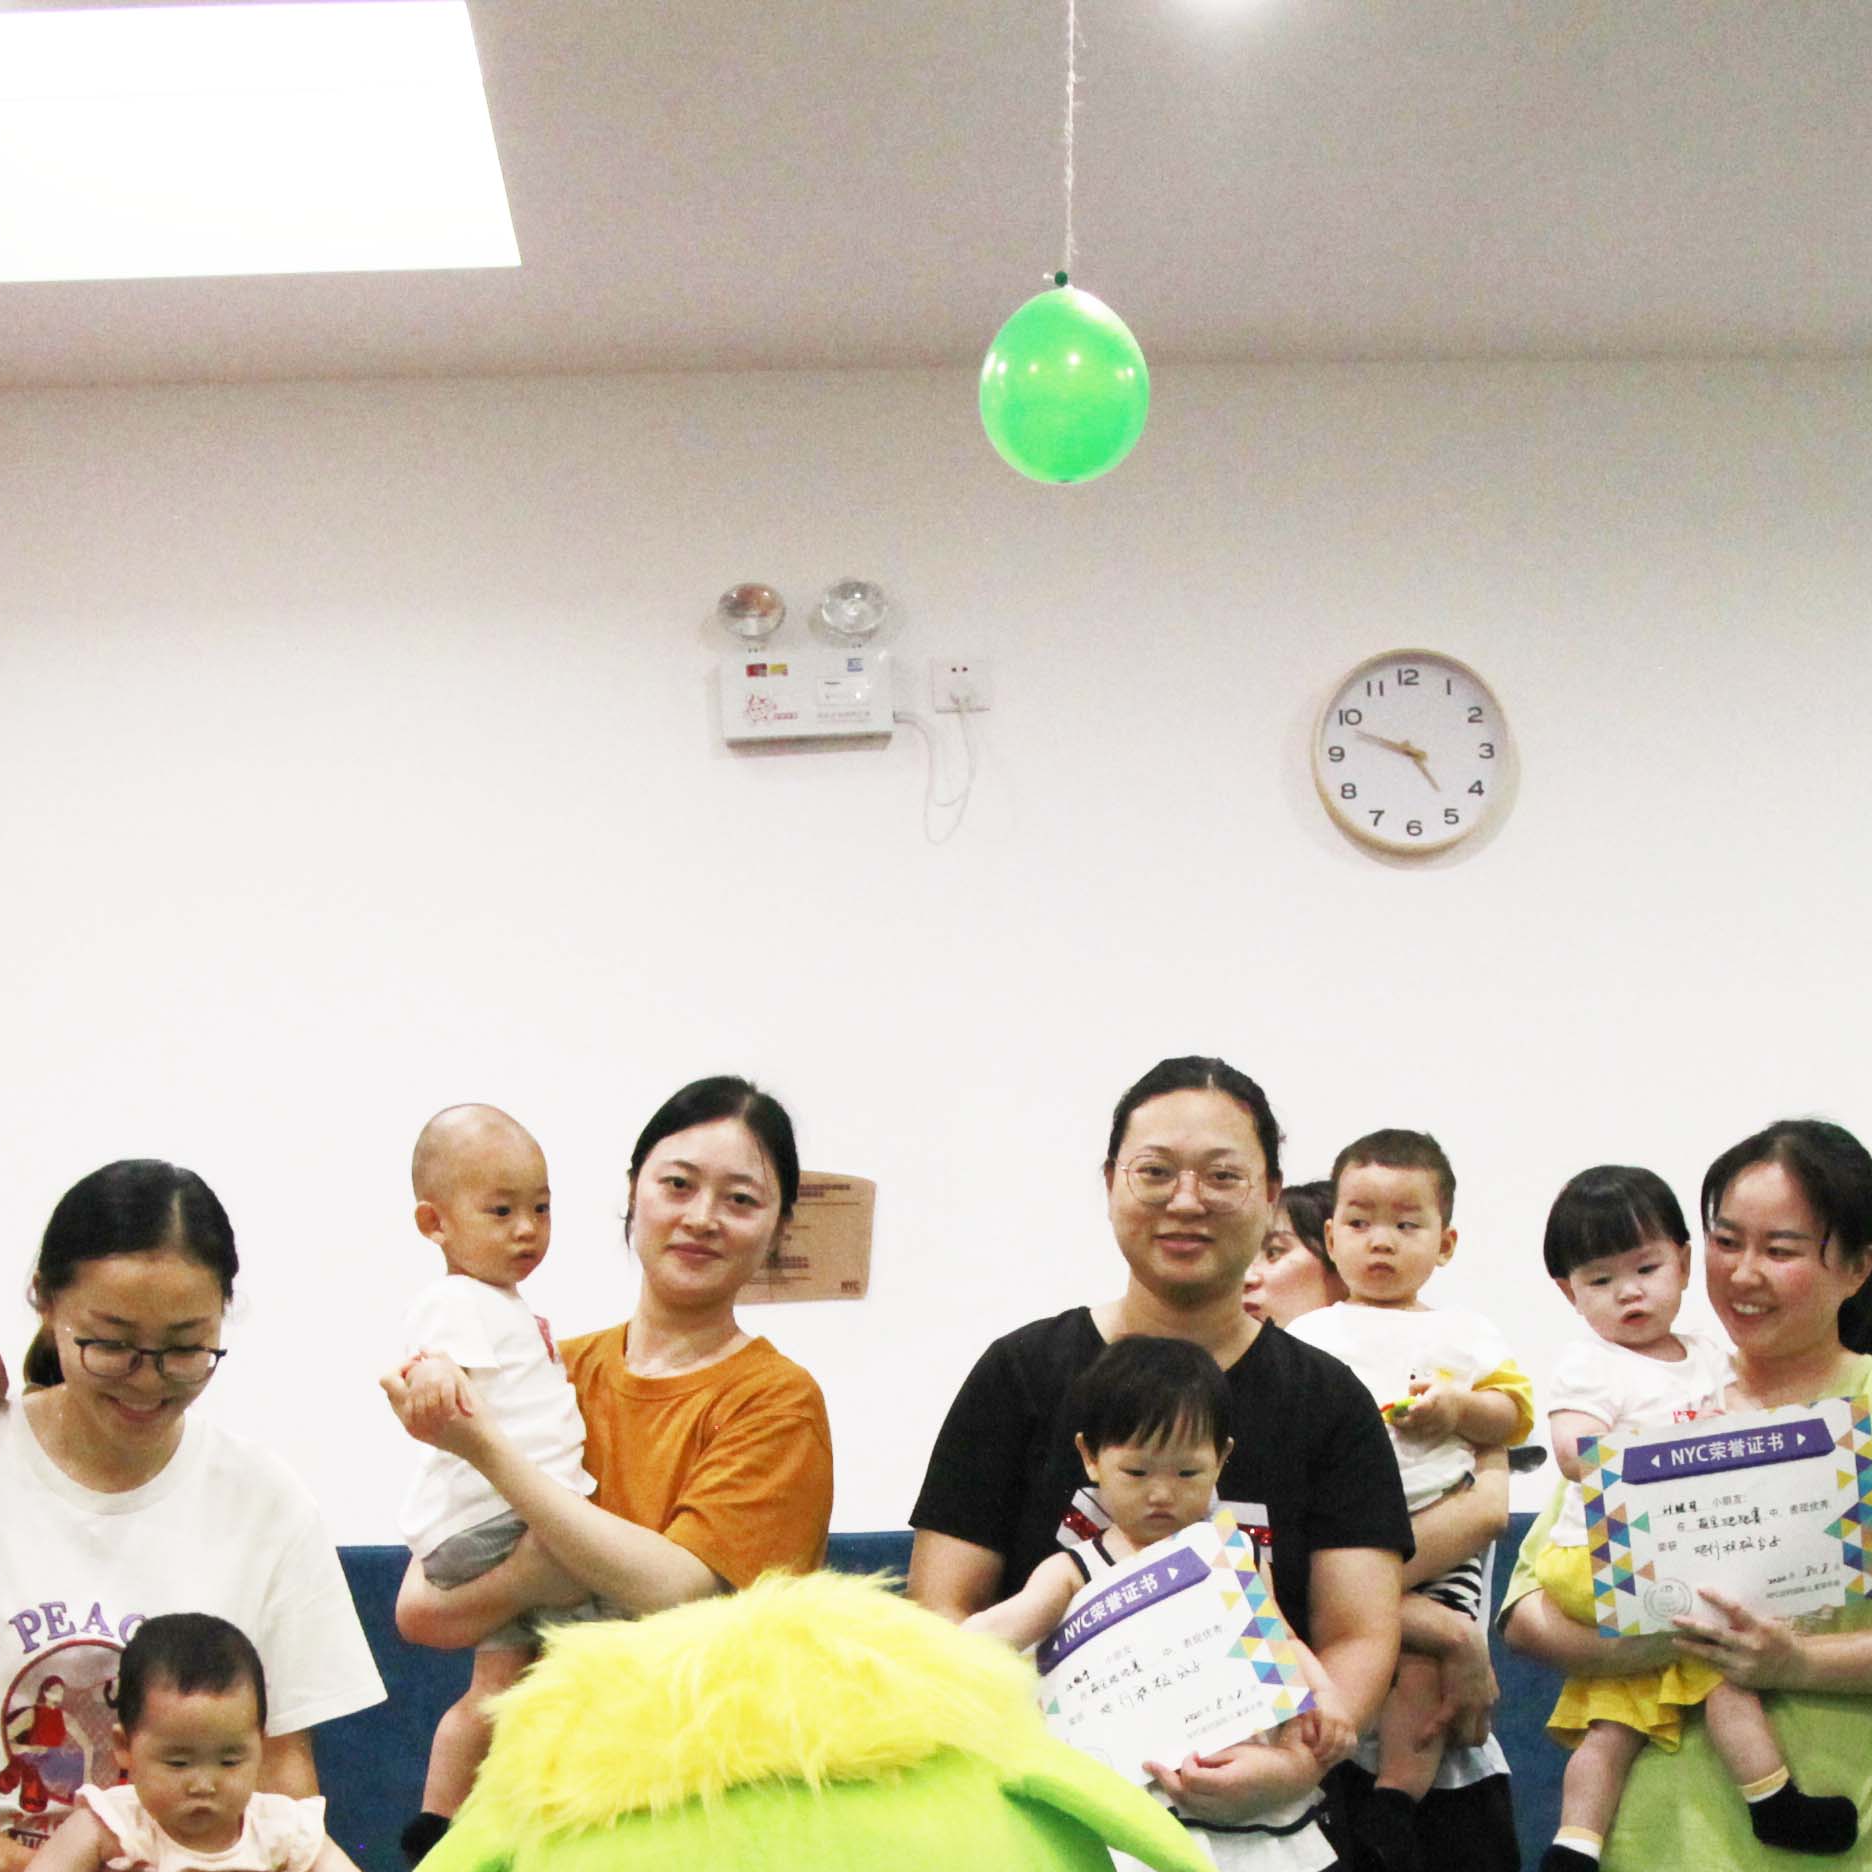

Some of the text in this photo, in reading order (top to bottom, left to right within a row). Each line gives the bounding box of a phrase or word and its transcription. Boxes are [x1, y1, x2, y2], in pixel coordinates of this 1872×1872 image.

[1397, 668, 1419, 686] 12
[1366, 681, 1384, 697] 11
[1338, 708, 1363, 726] 10
[1467, 706, 1483, 723] 2
[1327, 746, 1345, 762] 9
[1479, 743, 1495, 759] 3
[1340, 783, 1357, 799] 8
[1467, 780, 1484, 796] 4
[1369, 810, 1385, 826] 7
[1444, 808, 1460, 825] 5
[1406, 820, 1423, 836] 6
[1671, 1432, 1784, 1467] NYC荣誉证书
[1063, 1573, 1159, 1643] NYC荣誉证书
[9, 1600, 148, 1653] PEAC
